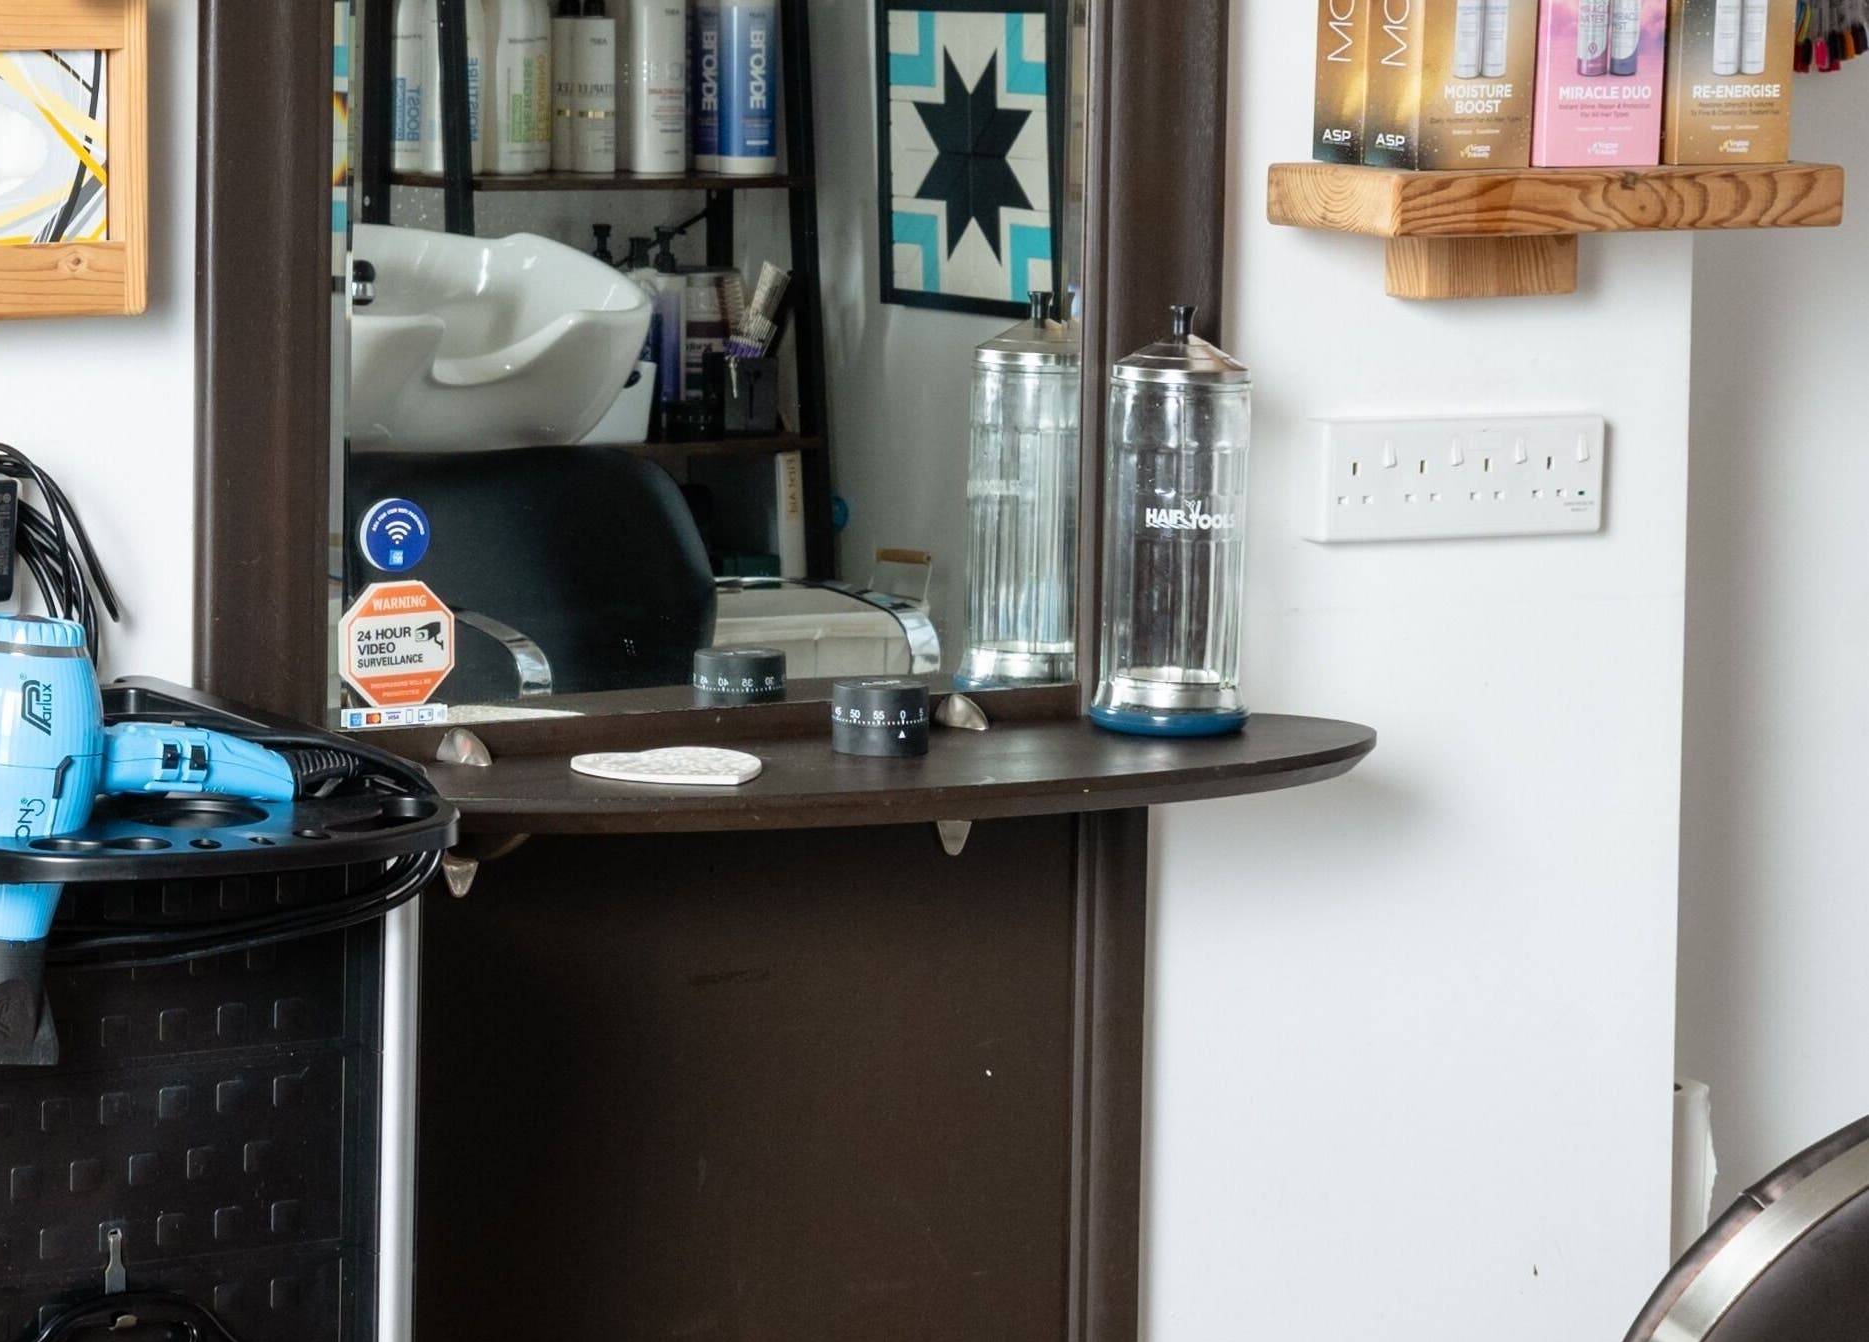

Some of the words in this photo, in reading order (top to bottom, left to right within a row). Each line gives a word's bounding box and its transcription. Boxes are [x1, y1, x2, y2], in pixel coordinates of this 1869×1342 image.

[1444, 84, 1513, 98] MOISTURE
[1559, 86, 1620, 100] MIRACLE
[1622, 86, 1652, 99] DUO
[1693, 84, 1781, 98] RE-ENERGISE
[1454, 99, 1502, 114] BOOST
[1322, 128, 1352, 142] ASP
[1375, 133, 1405, 147] ASP
[1145, 507, 1191, 529] HAIR
[372, 595, 427, 611] WARNING
[357, 630, 372, 642] 24
[376, 626, 412, 640] HOUR
[358, 641, 396, 655] VIDEO
[357, 653, 424, 668] SURVEILLANCE
[21, 679, 52, 736] Parlux
[849, 708, 861, 718] 50
[873, 710, 885, 720] 55
[899, 710, 907, 719] 0
